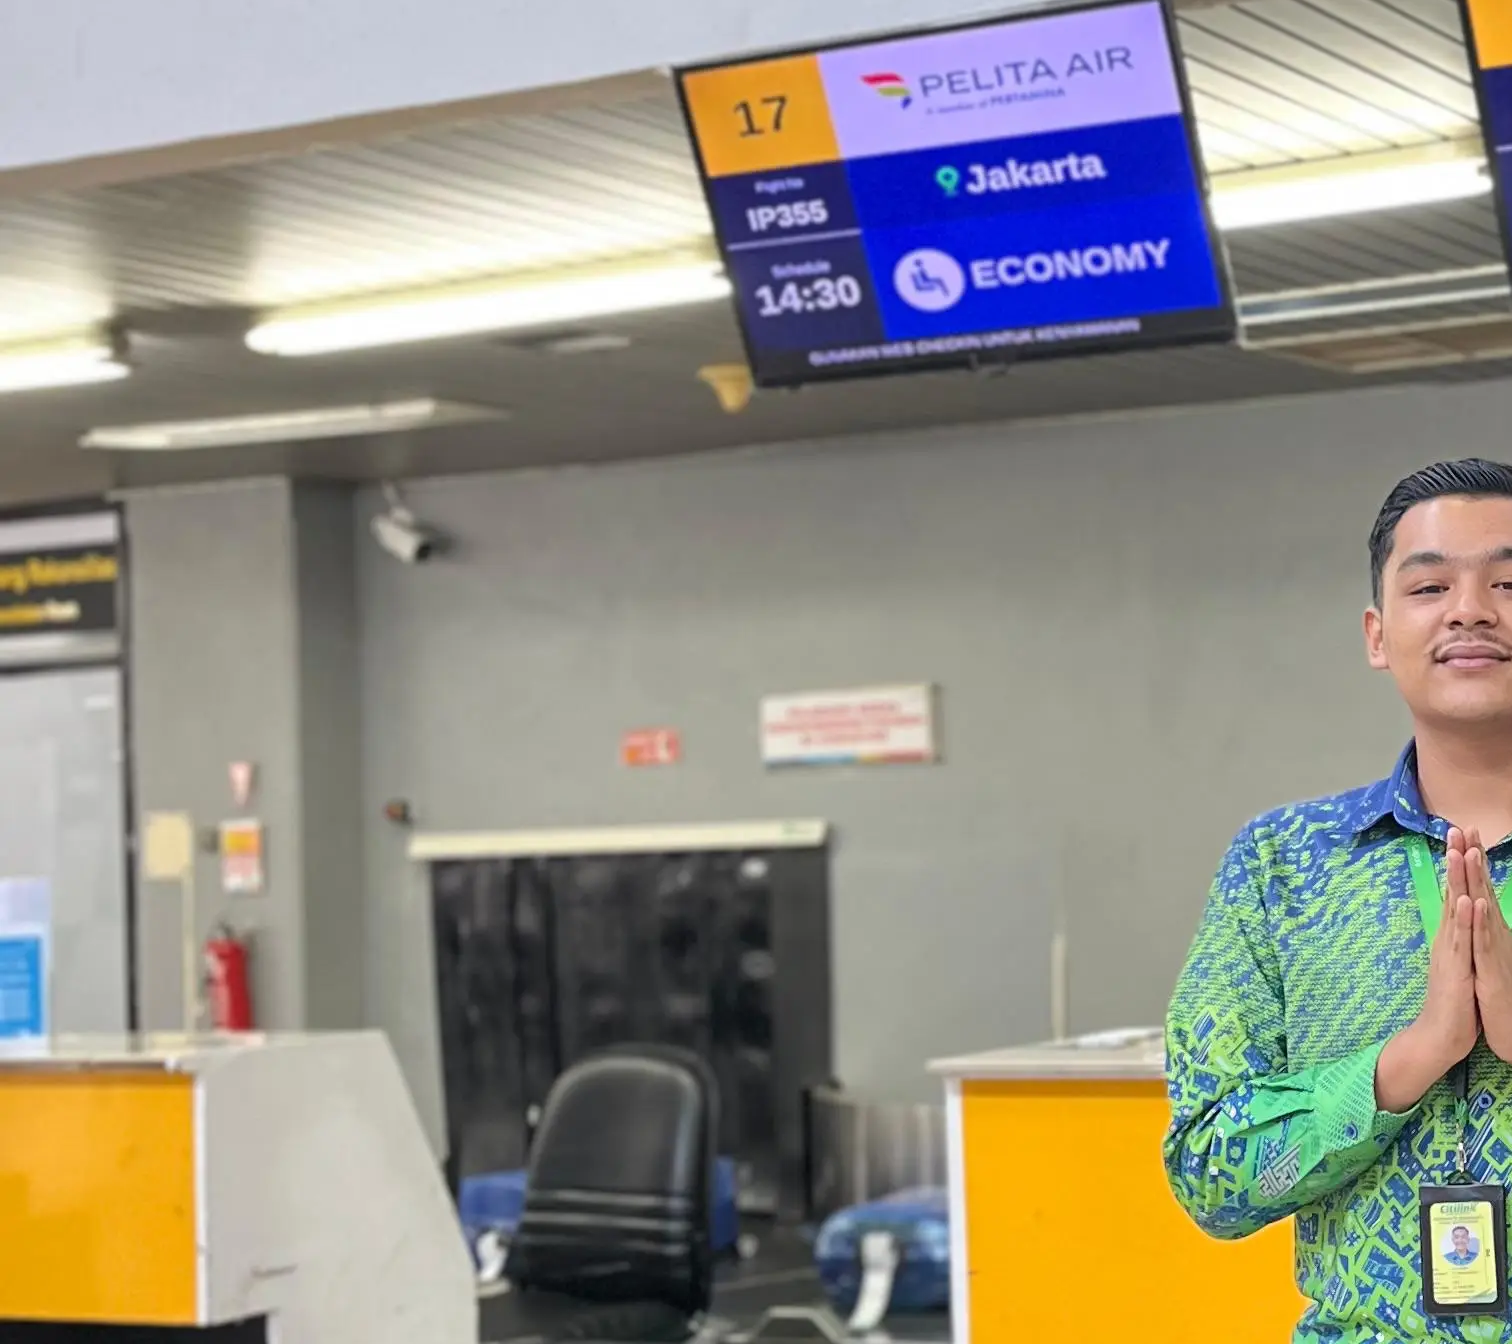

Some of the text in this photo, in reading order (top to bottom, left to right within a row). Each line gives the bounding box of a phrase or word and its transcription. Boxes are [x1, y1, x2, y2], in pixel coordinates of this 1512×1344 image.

[919, 46, 1135, 97] PELITA AIR
[733, 94, 787, 138] 17
[965, 153, 1107, 194] Jakarta
[746, 198, 829, 232] IP355
[970, 238, 1170, 289] ECONOMY
[755, 274, 862, 317] 14:30
